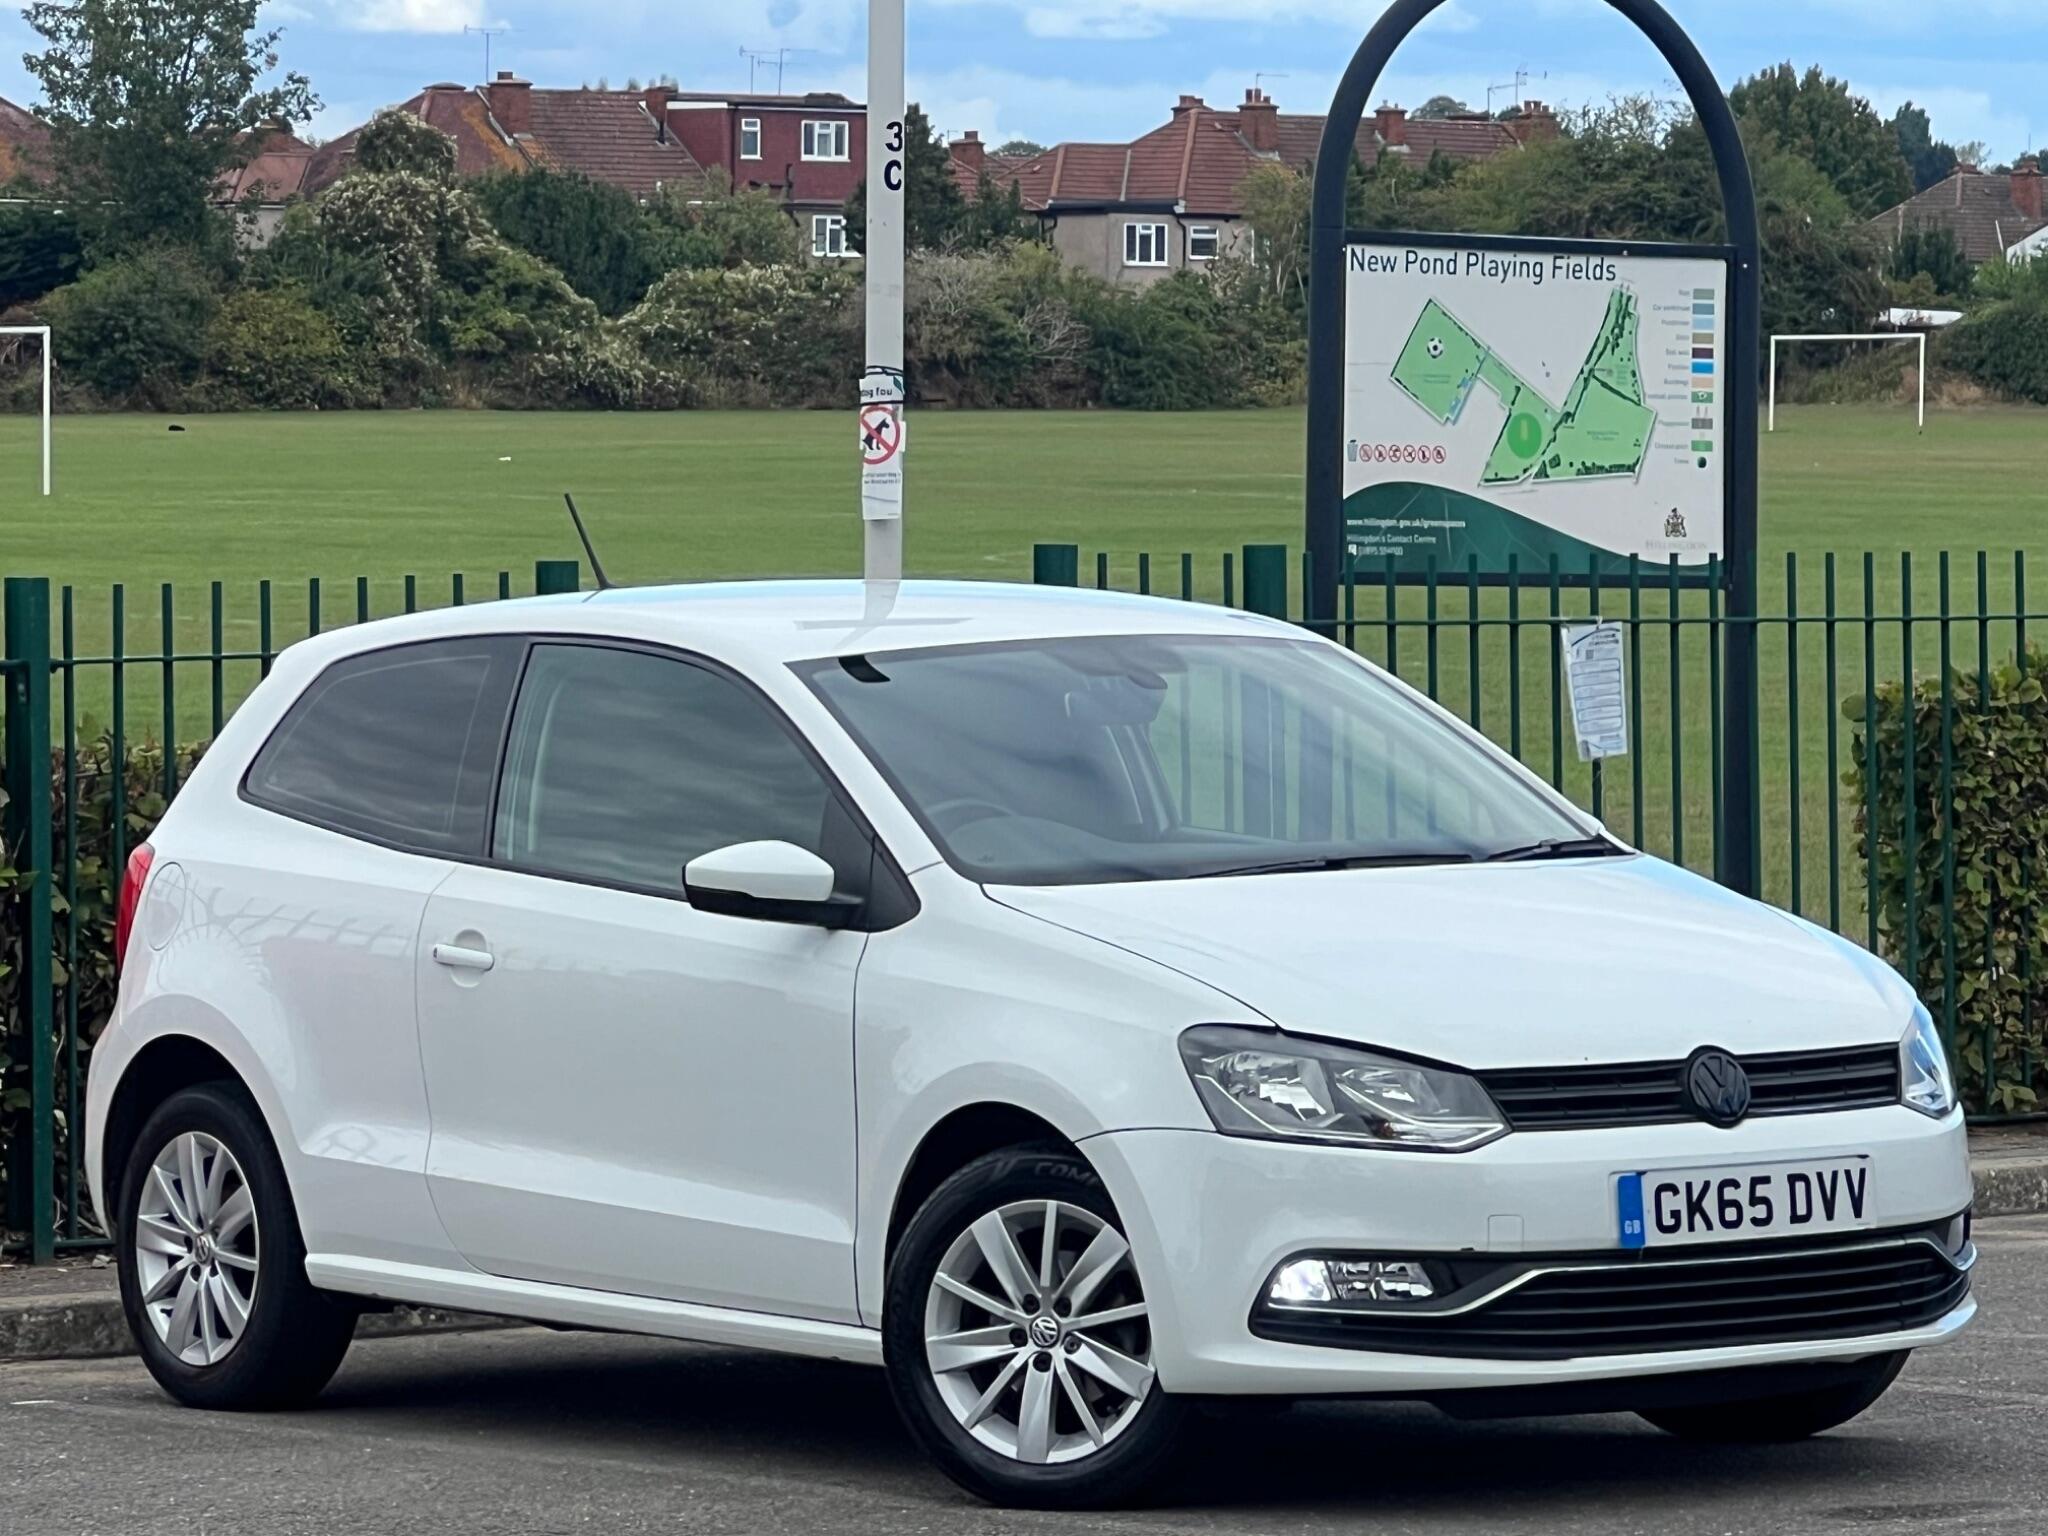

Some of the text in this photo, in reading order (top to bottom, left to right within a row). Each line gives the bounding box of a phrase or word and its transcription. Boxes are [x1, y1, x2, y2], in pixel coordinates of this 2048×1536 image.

[884, 121, 903, 152] 3
[884, 159, 902, 191] C
[1350, 247, 1616, 285] New Pond Playing Fields
[1654, 1168, 1866, 1235] GK65 DVV
[1624, 1220, 1641, 1234] GB
